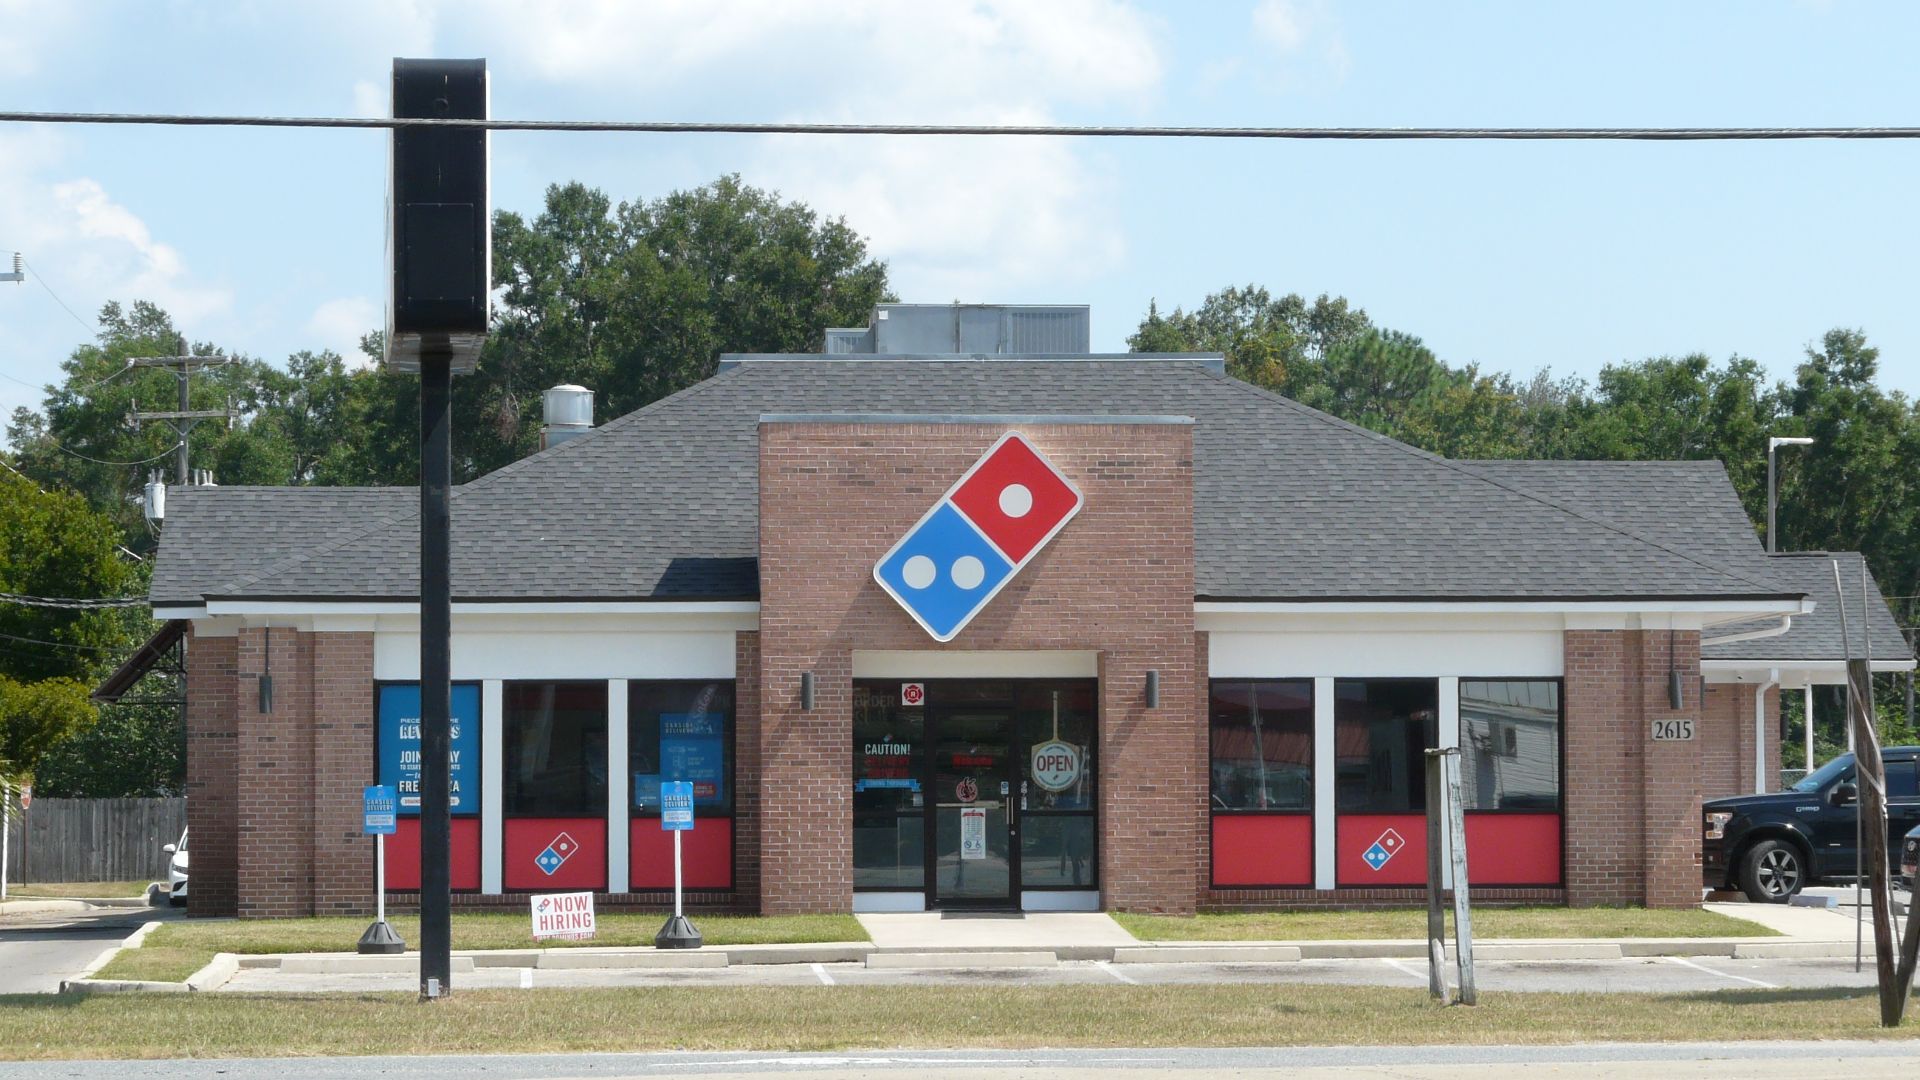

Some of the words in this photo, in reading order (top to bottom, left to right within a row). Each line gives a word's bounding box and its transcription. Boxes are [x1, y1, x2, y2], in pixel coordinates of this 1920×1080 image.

[1655, 721, 1692, 739] 2615
[400, 751, 421, 763] JOIN
[865, 743, 911, 755] CAUTION!
[1036, 755, 1074, 772] OPEN
[399, 780, 420, 792] FRE
[553, 896, 588, 912] NOW
[540, 912, 591, 930] HIRING
